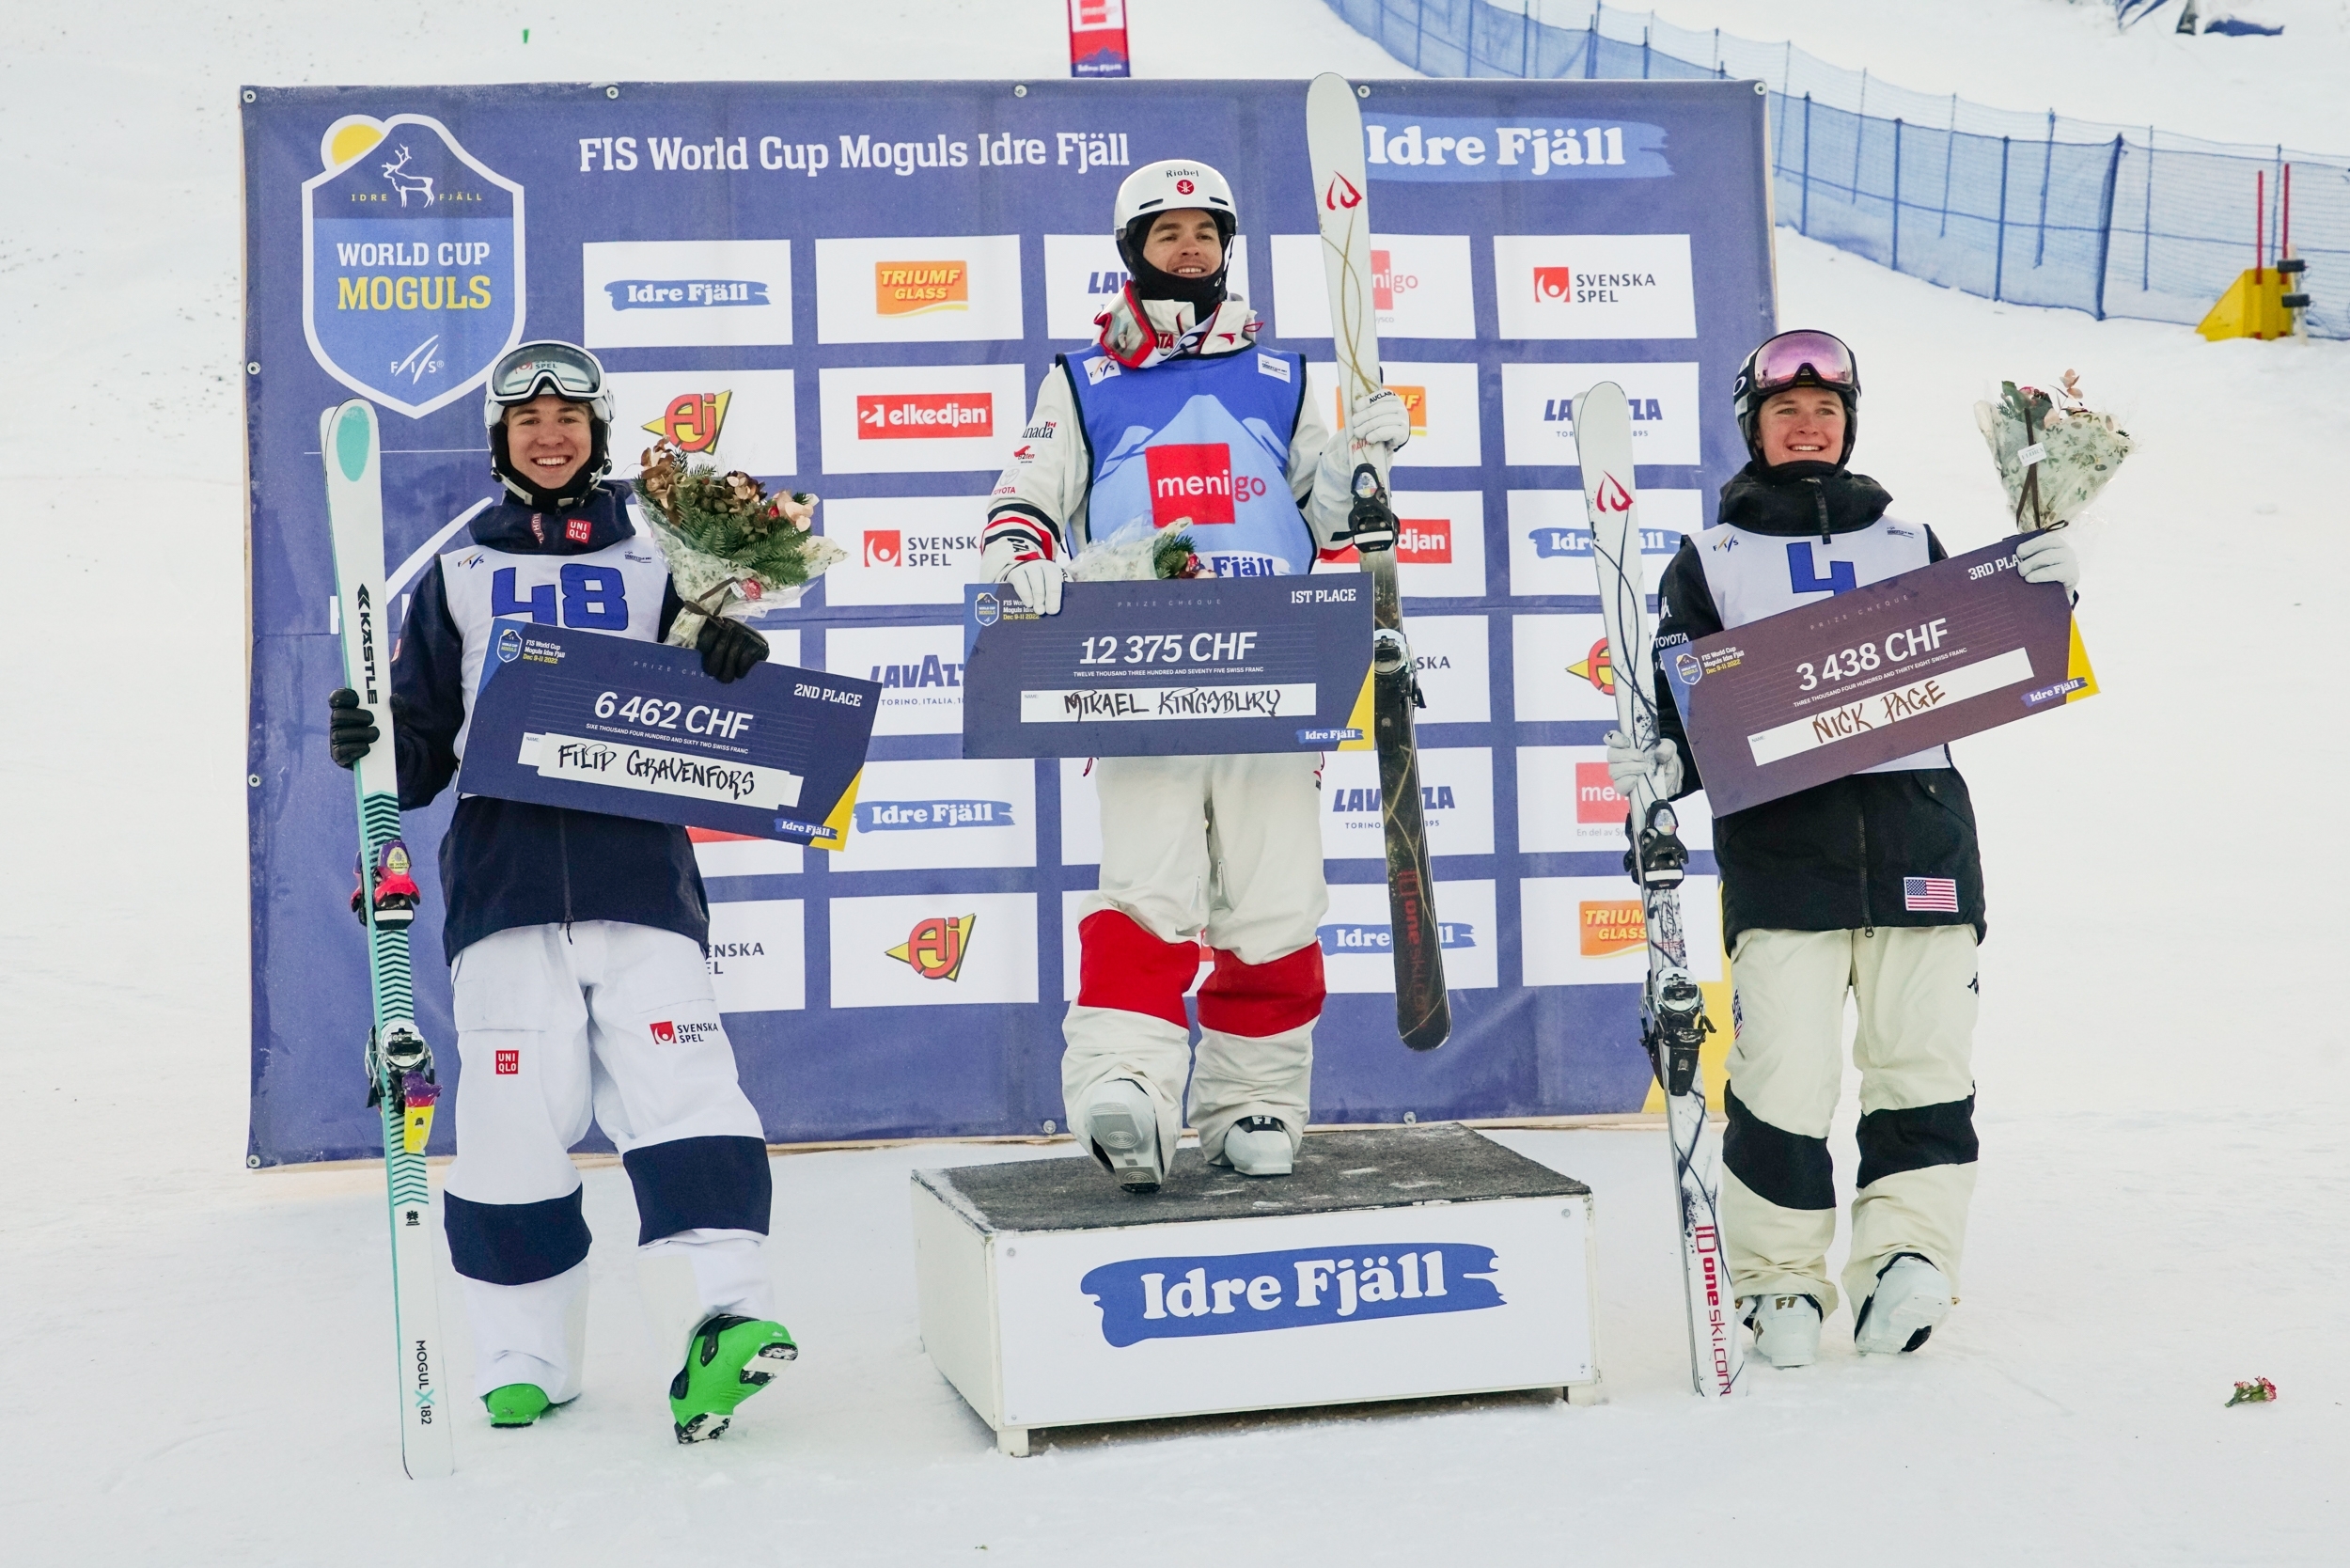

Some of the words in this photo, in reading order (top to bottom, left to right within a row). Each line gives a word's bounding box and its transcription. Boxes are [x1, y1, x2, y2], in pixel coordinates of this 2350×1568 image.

[580, 137, 637, 172] FIS
[649, 137, 748, 170] World
[760, 136, 829, 177] Cup
[840, 134, 968, 176] Moguls
[979, 133, 1046, 166] Idre
[1057, 133, 1130, 174] Fjäll
[1366, 125, 1485, 165] Idre
[1496, 127, 1626, 176] Fjäll
[1166, 168, 1199, 179] Riobel
[439, 191, 483, 201] FJÄLL
[337, 243, 429, 267] WORLD
[437, 242, 491, 266] CUP
[880, 268, 964, 288] TRIUMF
[1372, 269, 1418, 293] nigo
[1576, 273, 1656, 287] SVENSKA
[337, 275, 492, 311] MOGULS
[628, 284, 683, 304] Idre
[687, 282, 749, 307] Fjäll
[894, 287, 948, 301] GLASS
[1576, 290, 1619, 303] SPEL
[888, 403, 987, 428] elkedjan
[1544, 400, 1664, 421] LAZA
[1022, 421, 1053, 438] nada
[1157, 470, 1266, 502] menigo
[569, 529, 587, 540] QLO
[570, 521, 587, 531] UNI
[907, 536, 978, 551] SVENSK
[1551, 532, 1595, 551] Idr
[908, 553, 951, 567] SPEL
[1786, 541, 1857, 595] 4
[1967, 562, 1995, 580] 3RD
[1995, 554, 2023, 572] PLA
[492, 563, 629, 631] 48
[1291, 589, 1313, 604] 1ST
[1315, 588, 1356, 604] PLACE
[1810, 613, 1848, 631] PRIZE
[1857, 593, 1910, 616] CHEQUE
[1079, 636, 1117, 665] 12
[1124, 634, 1183, 663] 375
[1189, 632, 1258, 661] CHF
[1654, 632, 1689, 649] TOYOTA
[1796, 662, 1818, 691] 3
[1822, 642, 1881, 682] 438
[1885, 618, 1949, 662] CHF
[634, 661, 671, 672] PRIZE
[1794, 696, 1811, 708] THREE
[1811, 688, 1841, 702] THOUSAND
[1841, 682, 1857, 693] FOUR
[1857, 675, 1883, 688] HUNDRED
[1883, 671, 1895, 680] AND
[1895, 664, 1914, 675] THIRTY
[1914, 659, 1931, 668] EIGHT
[1931, 653, 1949, 664] SWISS
[1949, 647, 1967, 658] FRANC
[793, 683, 821, 700] 2ND
[822, 688, 863, 707] PLACE
[2029, 687, 2052, 703] Idre
[2052, 679, 2080, 699] Fjäll
[594, 691, 618, 719] 6
[619, 696, 681, 729] 462
[685, 704, 754, 740] CHF
[1064, 689, 1150, 723] MIKAEL
[1812, 702, 1873, 745] NICK
[1880, 680, 1946, 724] PAGE
[599, 725, 629, 735] THOUSAND
[644, 731, 671, 741] HUNDRED
[671, 735, 683, 744] AND
[713, 743, 729, 751] SWISS
[730, 745, 749, 754] FRANC
[1305, 730, 1327, 741] Idre
[1328, 729, 1356, 742] Fjäll
[1333, 786, 1456, 812] LAVZA
[872, 805, 928, 824] Idre
[932, 804, 993, 827] Fjäll
[781, 821, 805, 834] Idre
[806, 823, 830, 838] Fjäll
[1576, 828, 1589, 837] En
[1590, 828, 1602, 837] del
[1585, 908, 1645, 926] TRIUM
[1337, 929, 1390, 947] Idre
[1598, 927, 1648, 940] GLASS
[709, 942, 764, 958] NSKA
[677, 1022, 718, 1033] SVENSKA
[679, 1034, 705, 1043] SPEL
[497, 1054, 516, 1062] UNI
[497, 1063, 517, 1073] QLO
[1141, 1268, 1281, 1320] Idre
[1293, 1250, 1449, 1316] Fjäll
[1776, 1296, 1797, 1310] FT
[415, 1340, 431, 1389] MOGUL
[420, 1405, 432, 1425] 182
